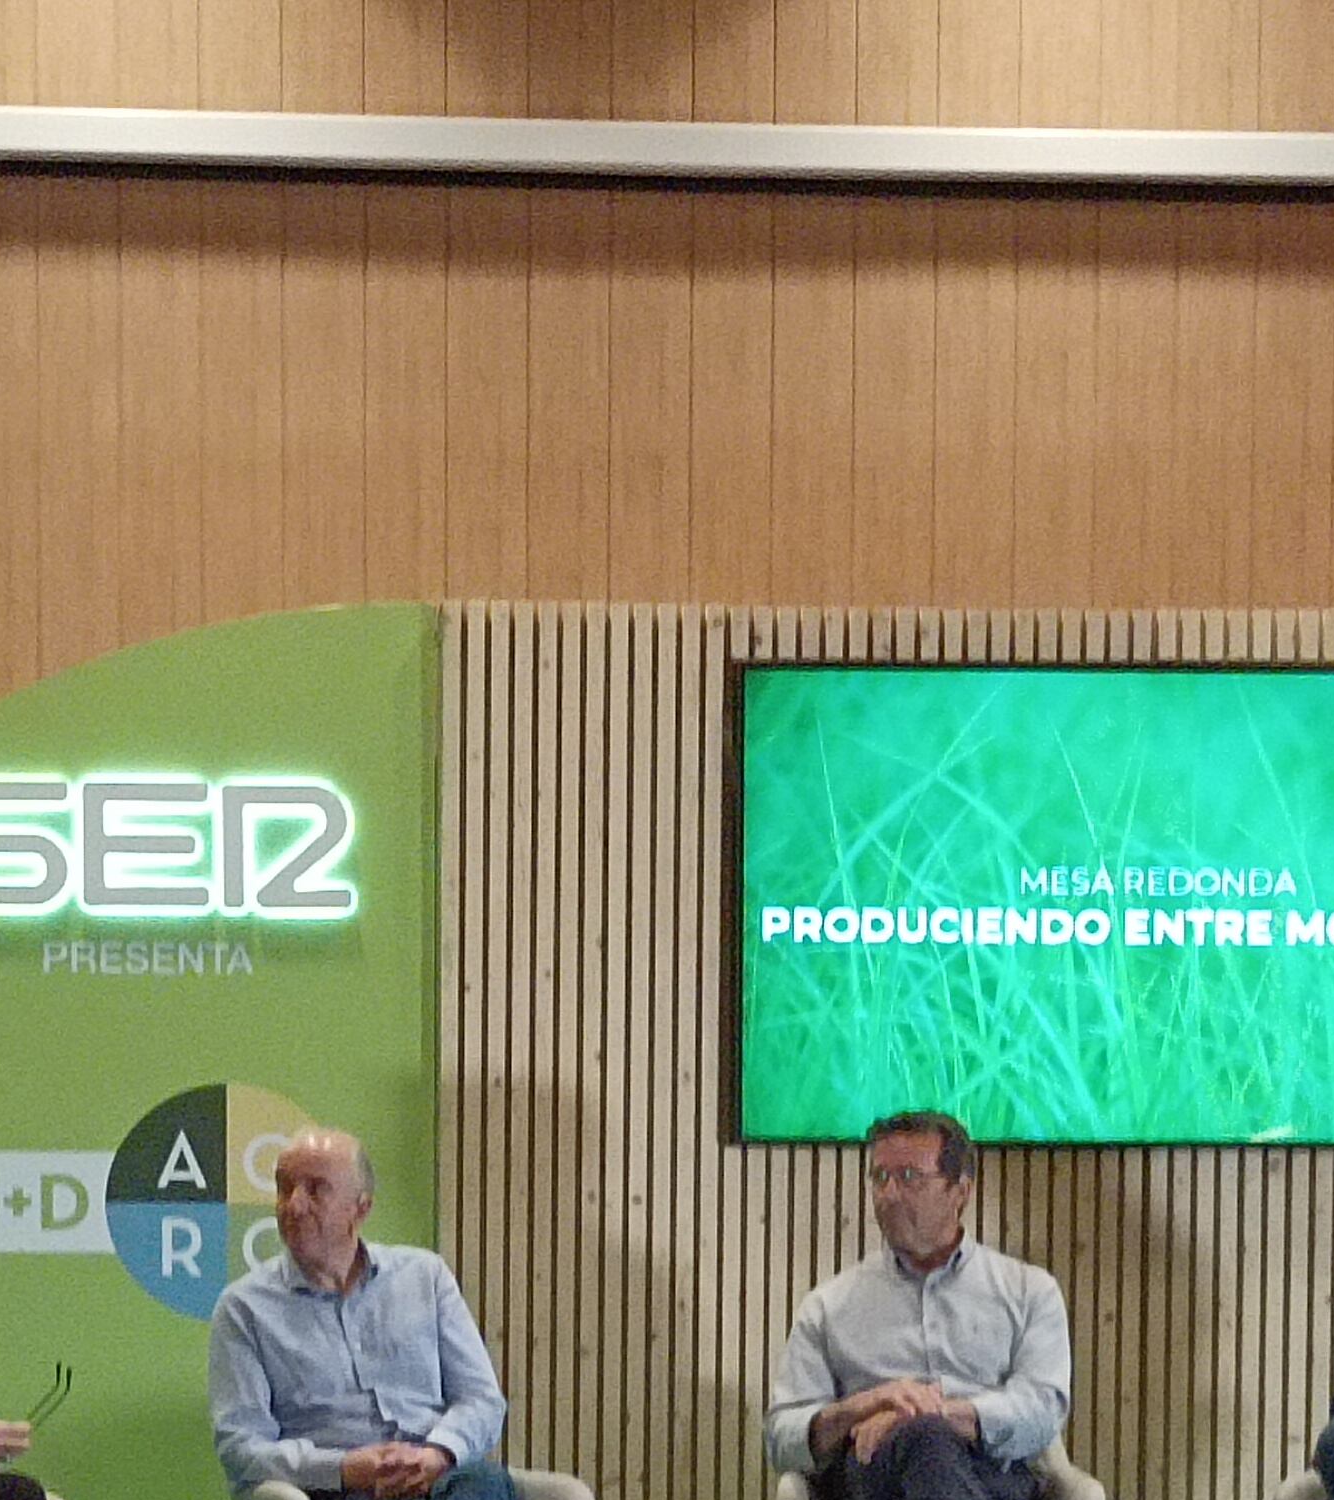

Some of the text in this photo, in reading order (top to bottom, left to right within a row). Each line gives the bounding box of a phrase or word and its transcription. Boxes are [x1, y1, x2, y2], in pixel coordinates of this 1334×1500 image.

[1020, 865, 1298, 898] MESA REDONDA
[761, 905, 1112, 947] PRODUCIENDO
[1123, 907, 1273, 948] ENTRE
[42, 940, 254, 975] PRESENTA
